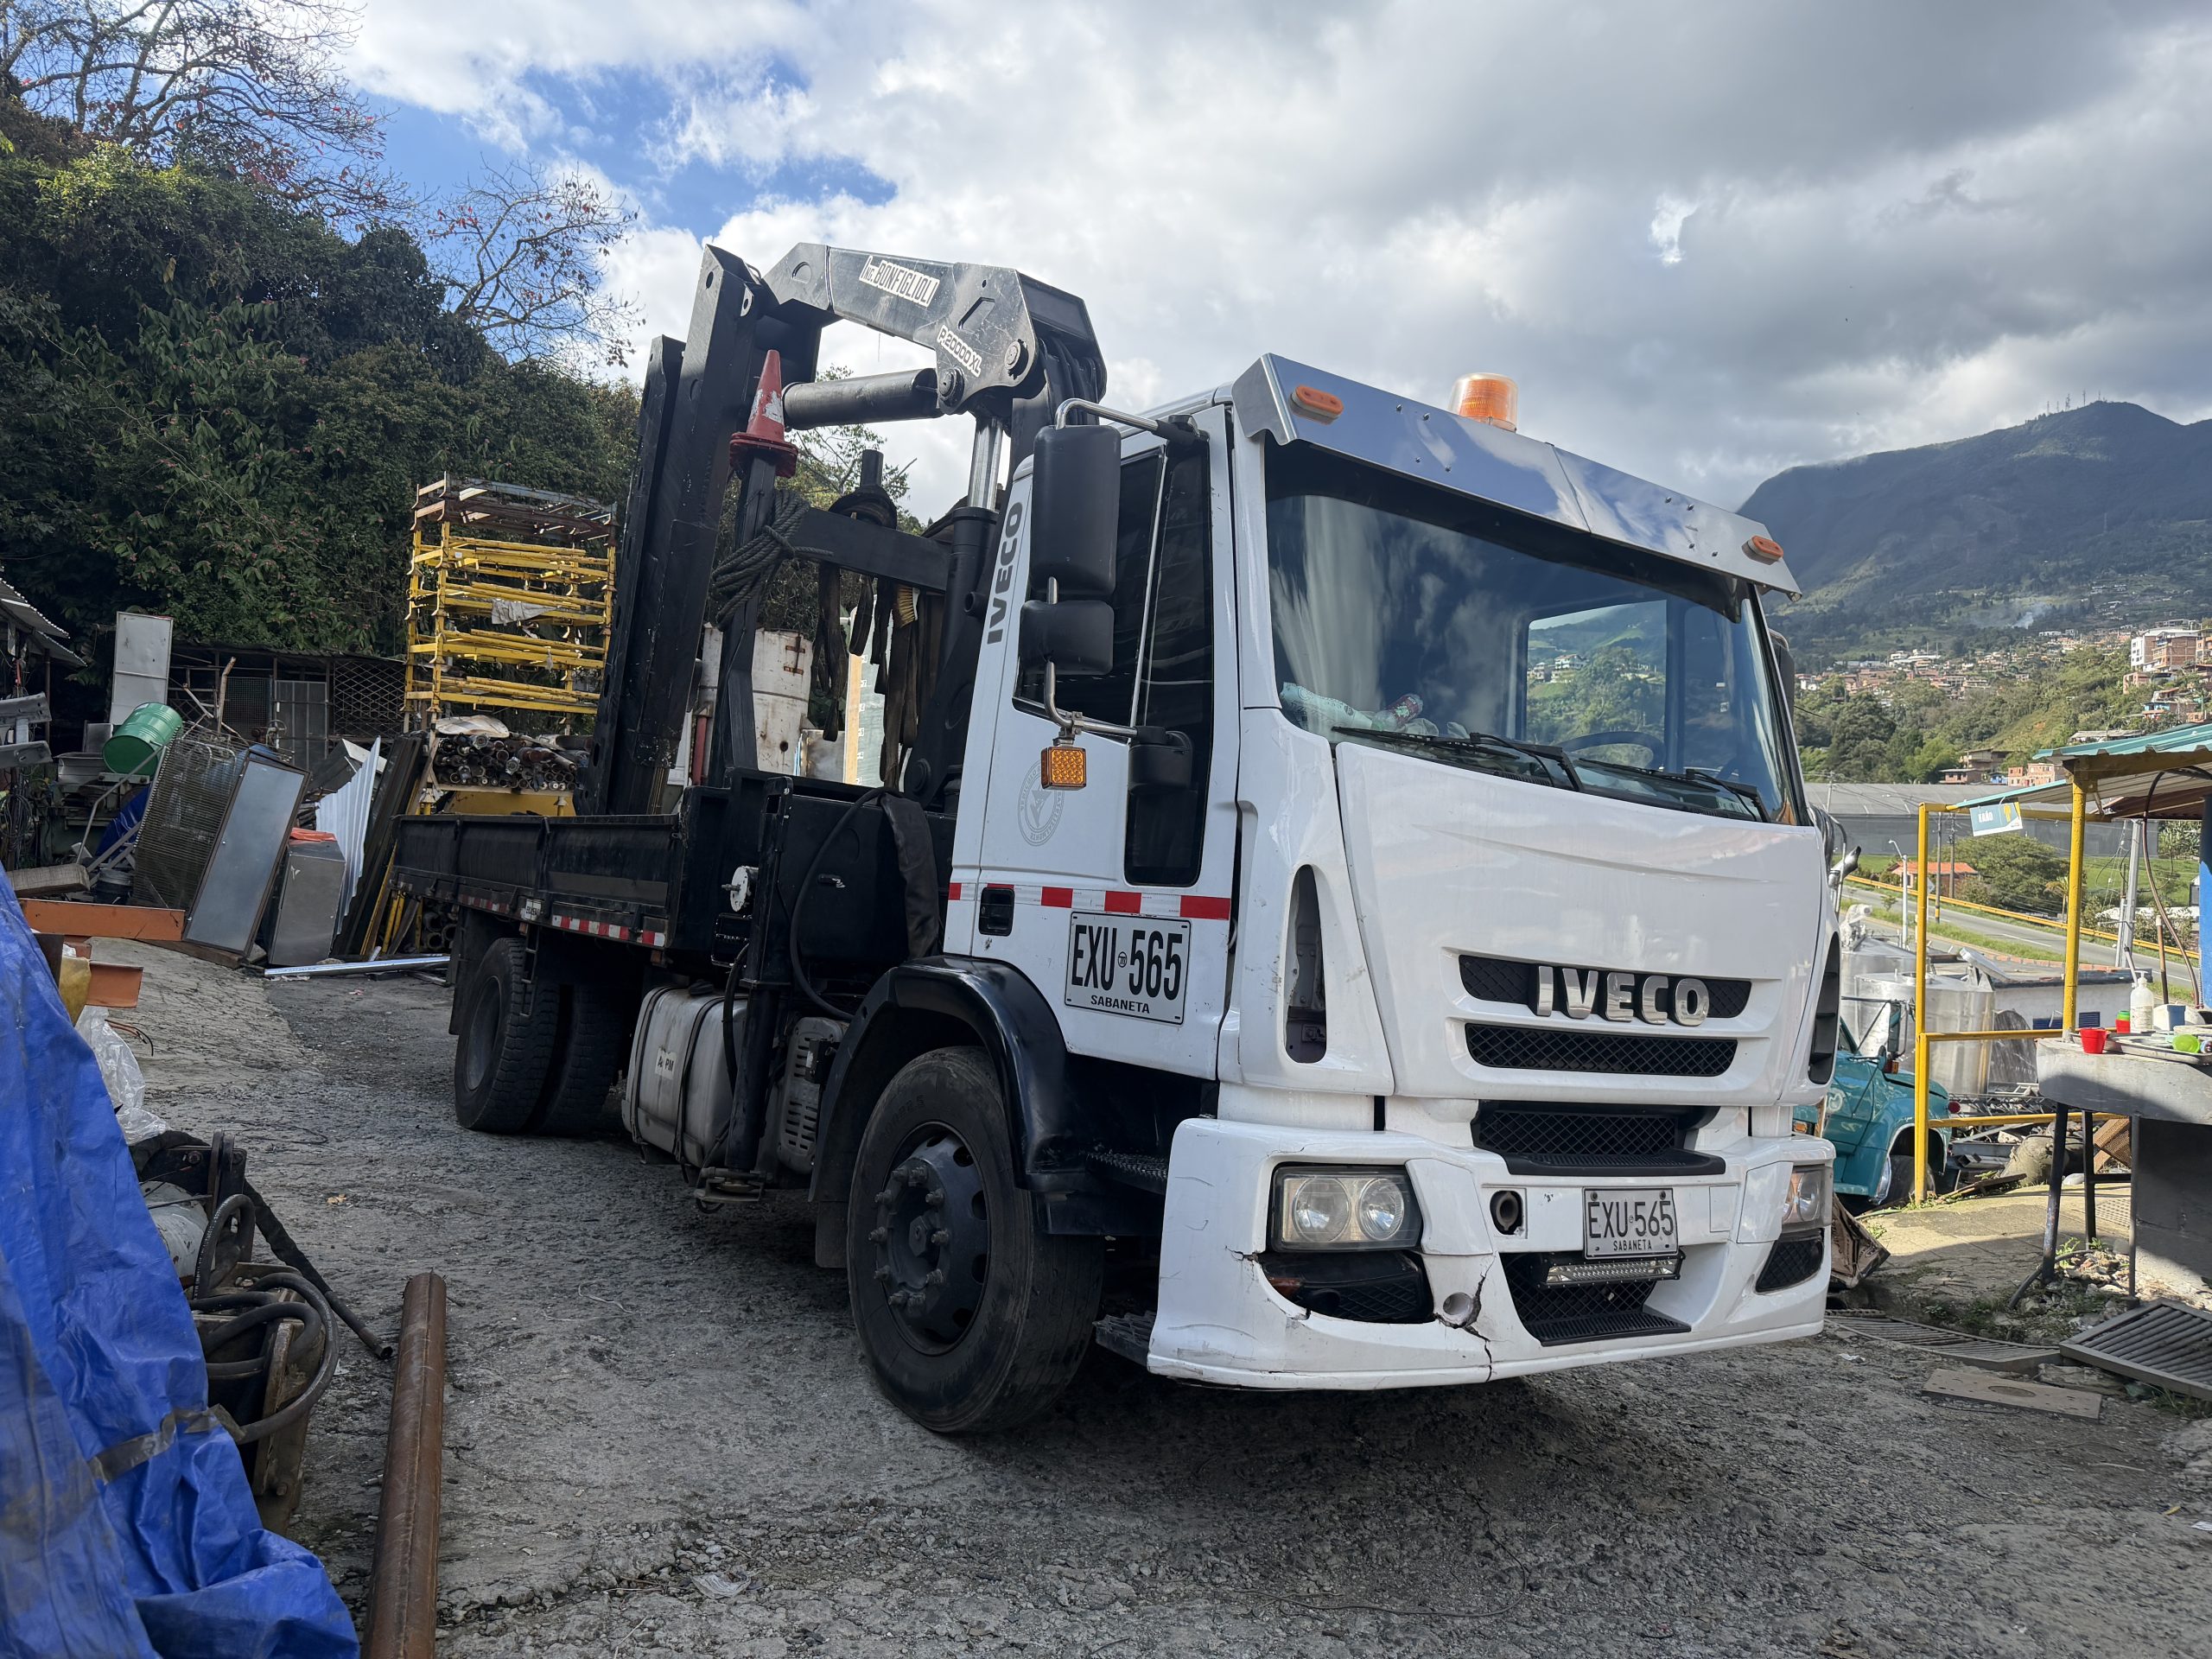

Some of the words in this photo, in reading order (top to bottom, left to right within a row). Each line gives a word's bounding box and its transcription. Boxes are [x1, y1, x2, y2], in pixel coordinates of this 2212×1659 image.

[874, 263, 938, 305] BONFIGLIOLI
[987, 501, 1023, 645] IVECO
[1090, 995, 1151, 1014] SABANETA
[1535, 964, 1711, 1027] IVECO
[1612, 1239, 1653, 1251] SABANETA
